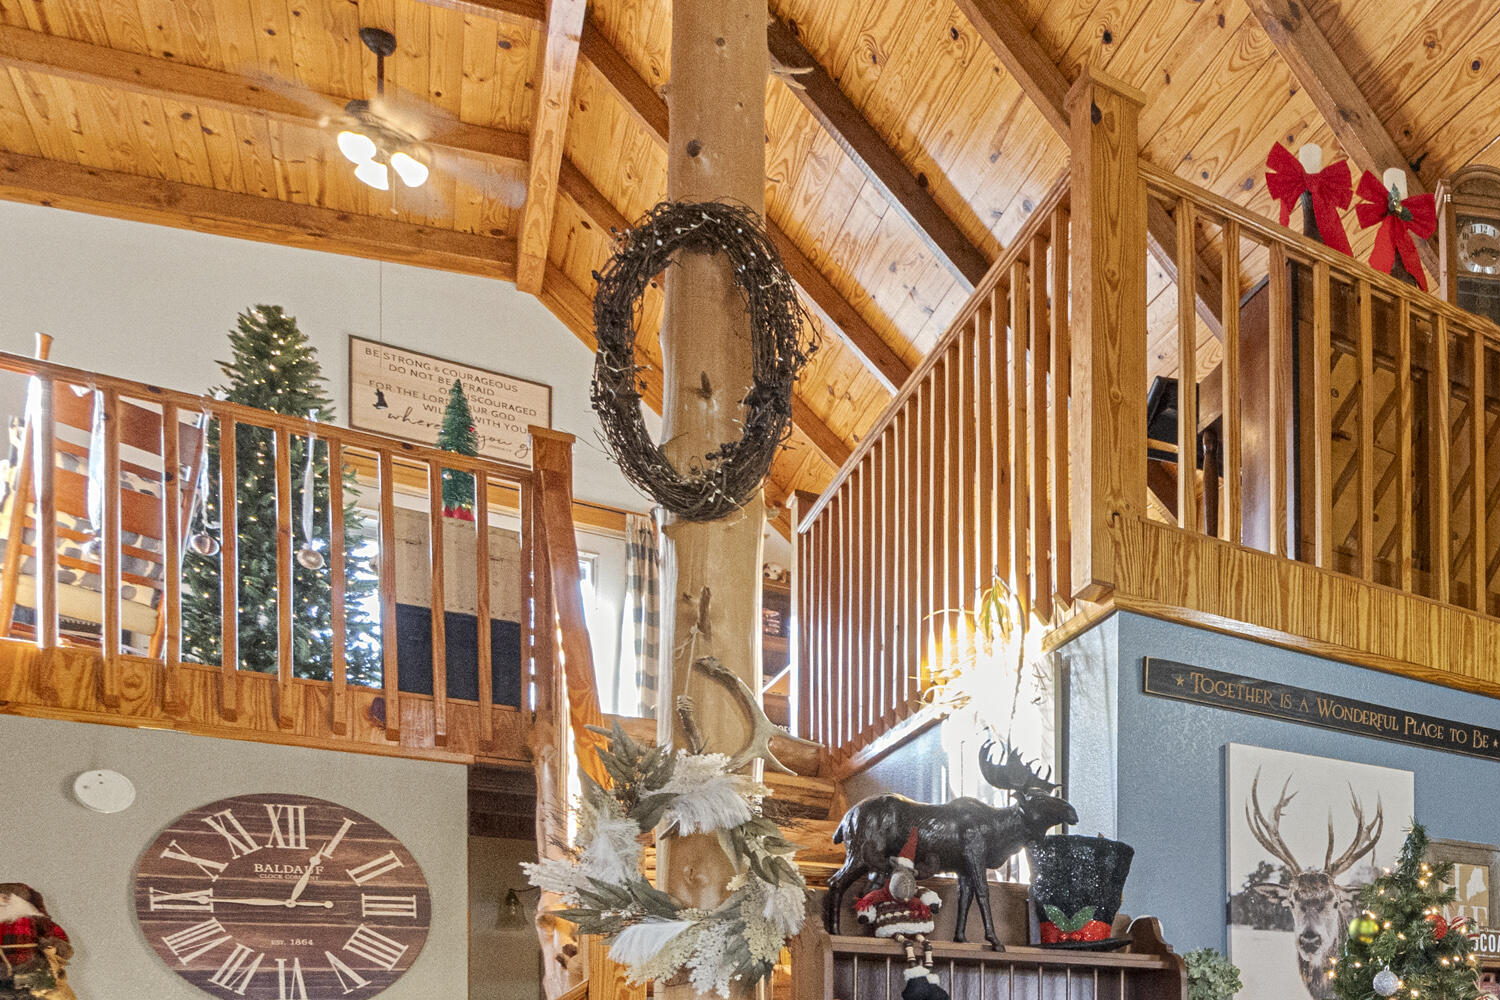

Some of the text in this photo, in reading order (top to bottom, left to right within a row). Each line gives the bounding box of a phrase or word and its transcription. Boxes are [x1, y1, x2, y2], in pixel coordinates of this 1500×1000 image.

[365, 347, 381, 358] BE
[383, 352, 431, 371] STRONG
[442, 367, 518, 393] COURAGEOUS
[388, 363, 406, 375] DO
[410, 369, 433, 381] NOT
[462, 382, 495, 396] FRAID
[369, 380, 392, 392] FOR
[397, 386, 419, 398] THE
[491, 410, 515, 421] GOD
[466, 393, 537, 416] ISCOURAGED
[1190, 671, 1489, 749] TOGETHER IS A WONDERFUL PLACE TO BE
[264, 803, 310, 850] XII
